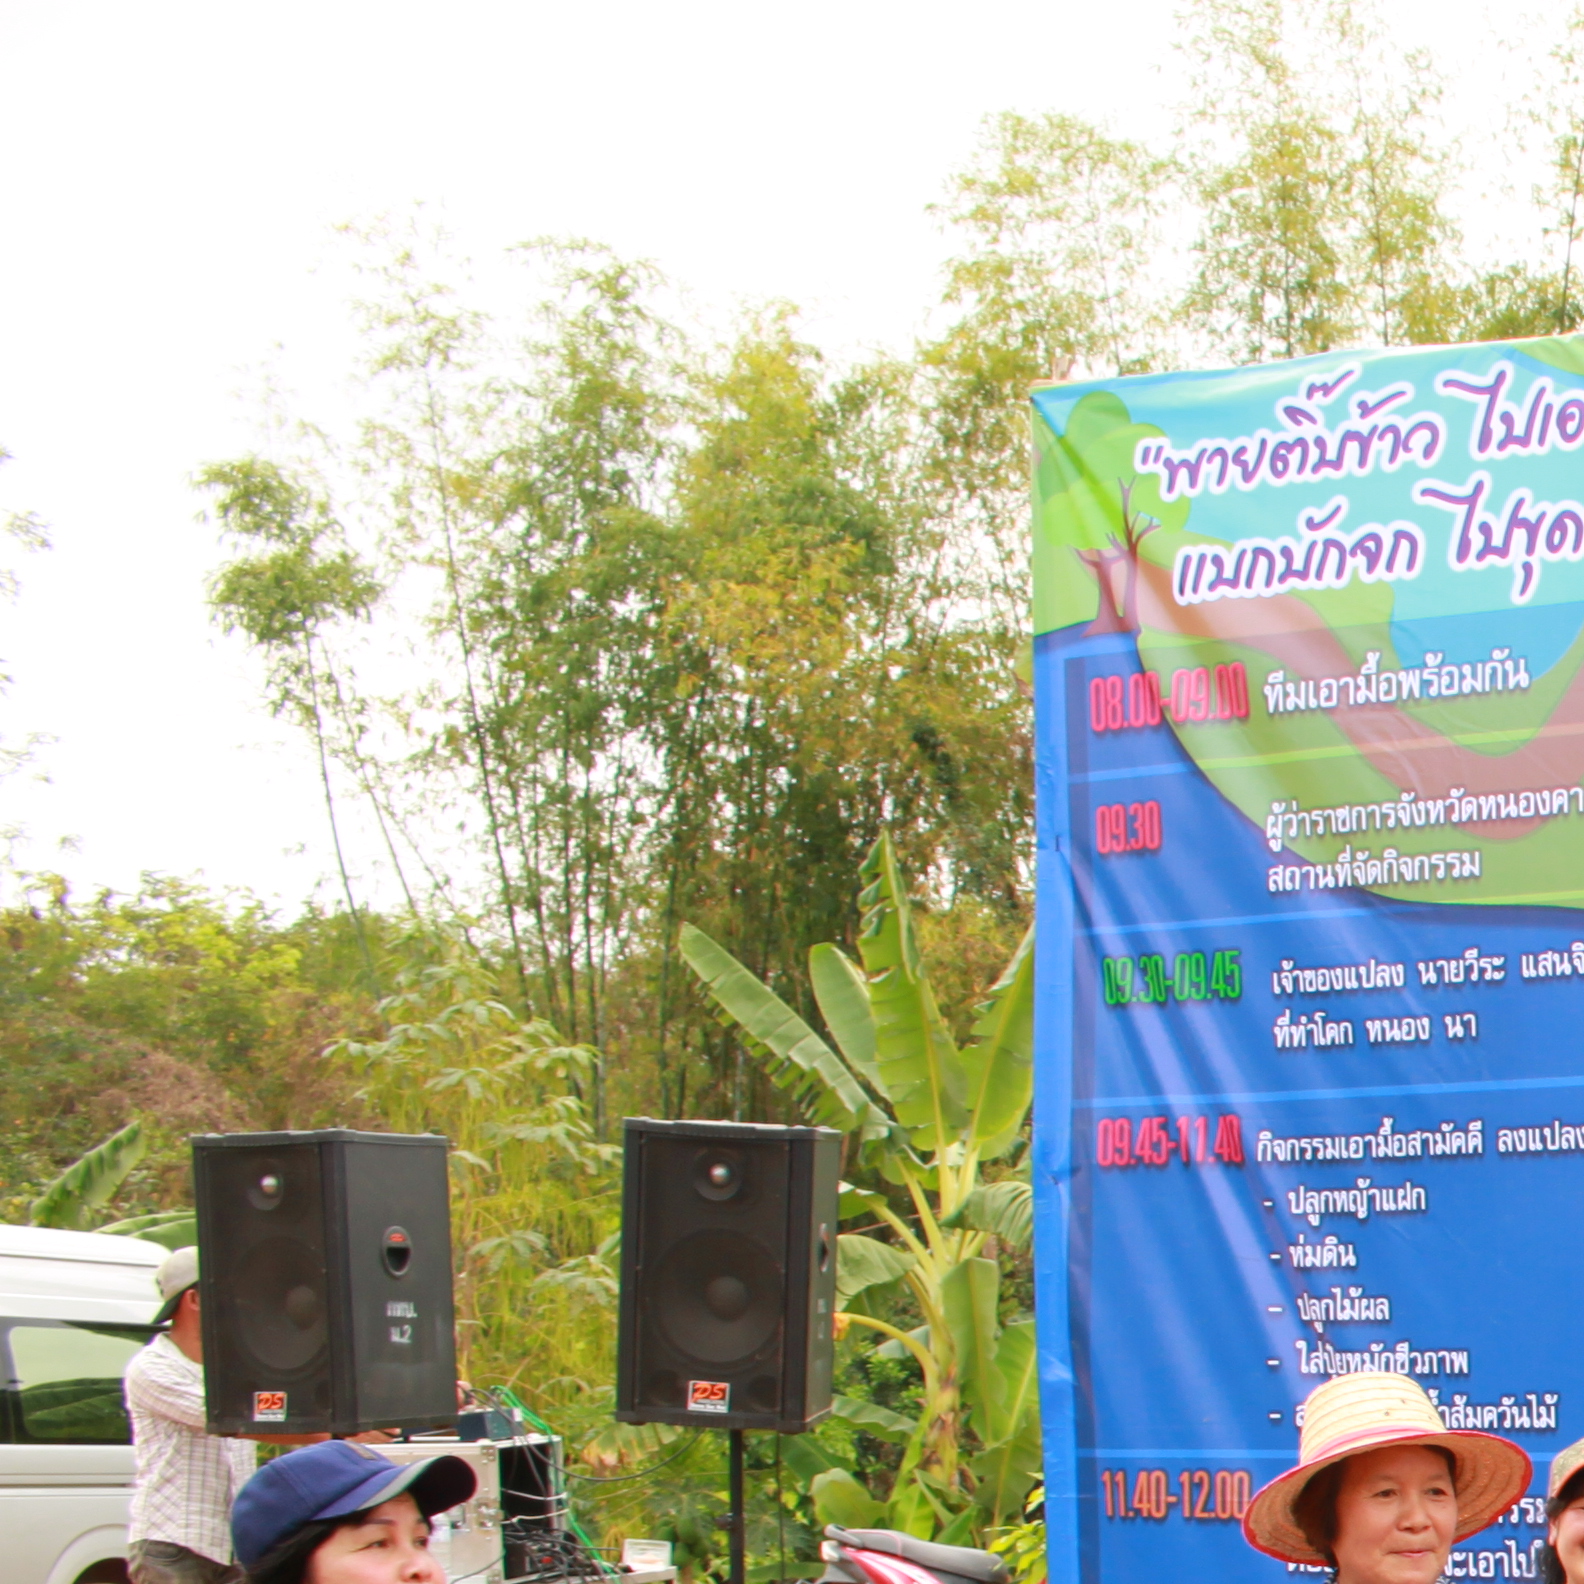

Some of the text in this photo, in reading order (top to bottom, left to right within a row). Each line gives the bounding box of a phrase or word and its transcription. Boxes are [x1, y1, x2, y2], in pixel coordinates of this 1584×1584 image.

[1090, 662, 1250, 732] 08.00-09.00
[1263, 648, 1530, 714] ทีมเอามื้อพร้อมกัน
[1095, 801, 1162, 854] 09.30
[1266, 845, 1481, 893] สถานที่จัดกิจกรรม
[1103, 949, 1242, 1005] 09.30-09.45
[1272, 958, 1404, 996] เจ้าของแปลง
[1418, 947, 1505, 985] นายวีระ
[1273, 1009, 1477, 1049] ที่ทำโคก หนอง นา
[1097, 1114, 1245, 1167] 09.45-11.40
[1257, 1117, 1484, 1163] กิจกรรมเอามื้อสามัคคี
[1288, 1178, 1426, 1226] ปลูกหญ้าแฝก
[1289, 1234, 1357, 1268] ห่มดิน
[1297, 1287, 1390, 1333] ปลูกไม้ผล
[1101, 1470, 1250, 1519] 11.40-12.00
